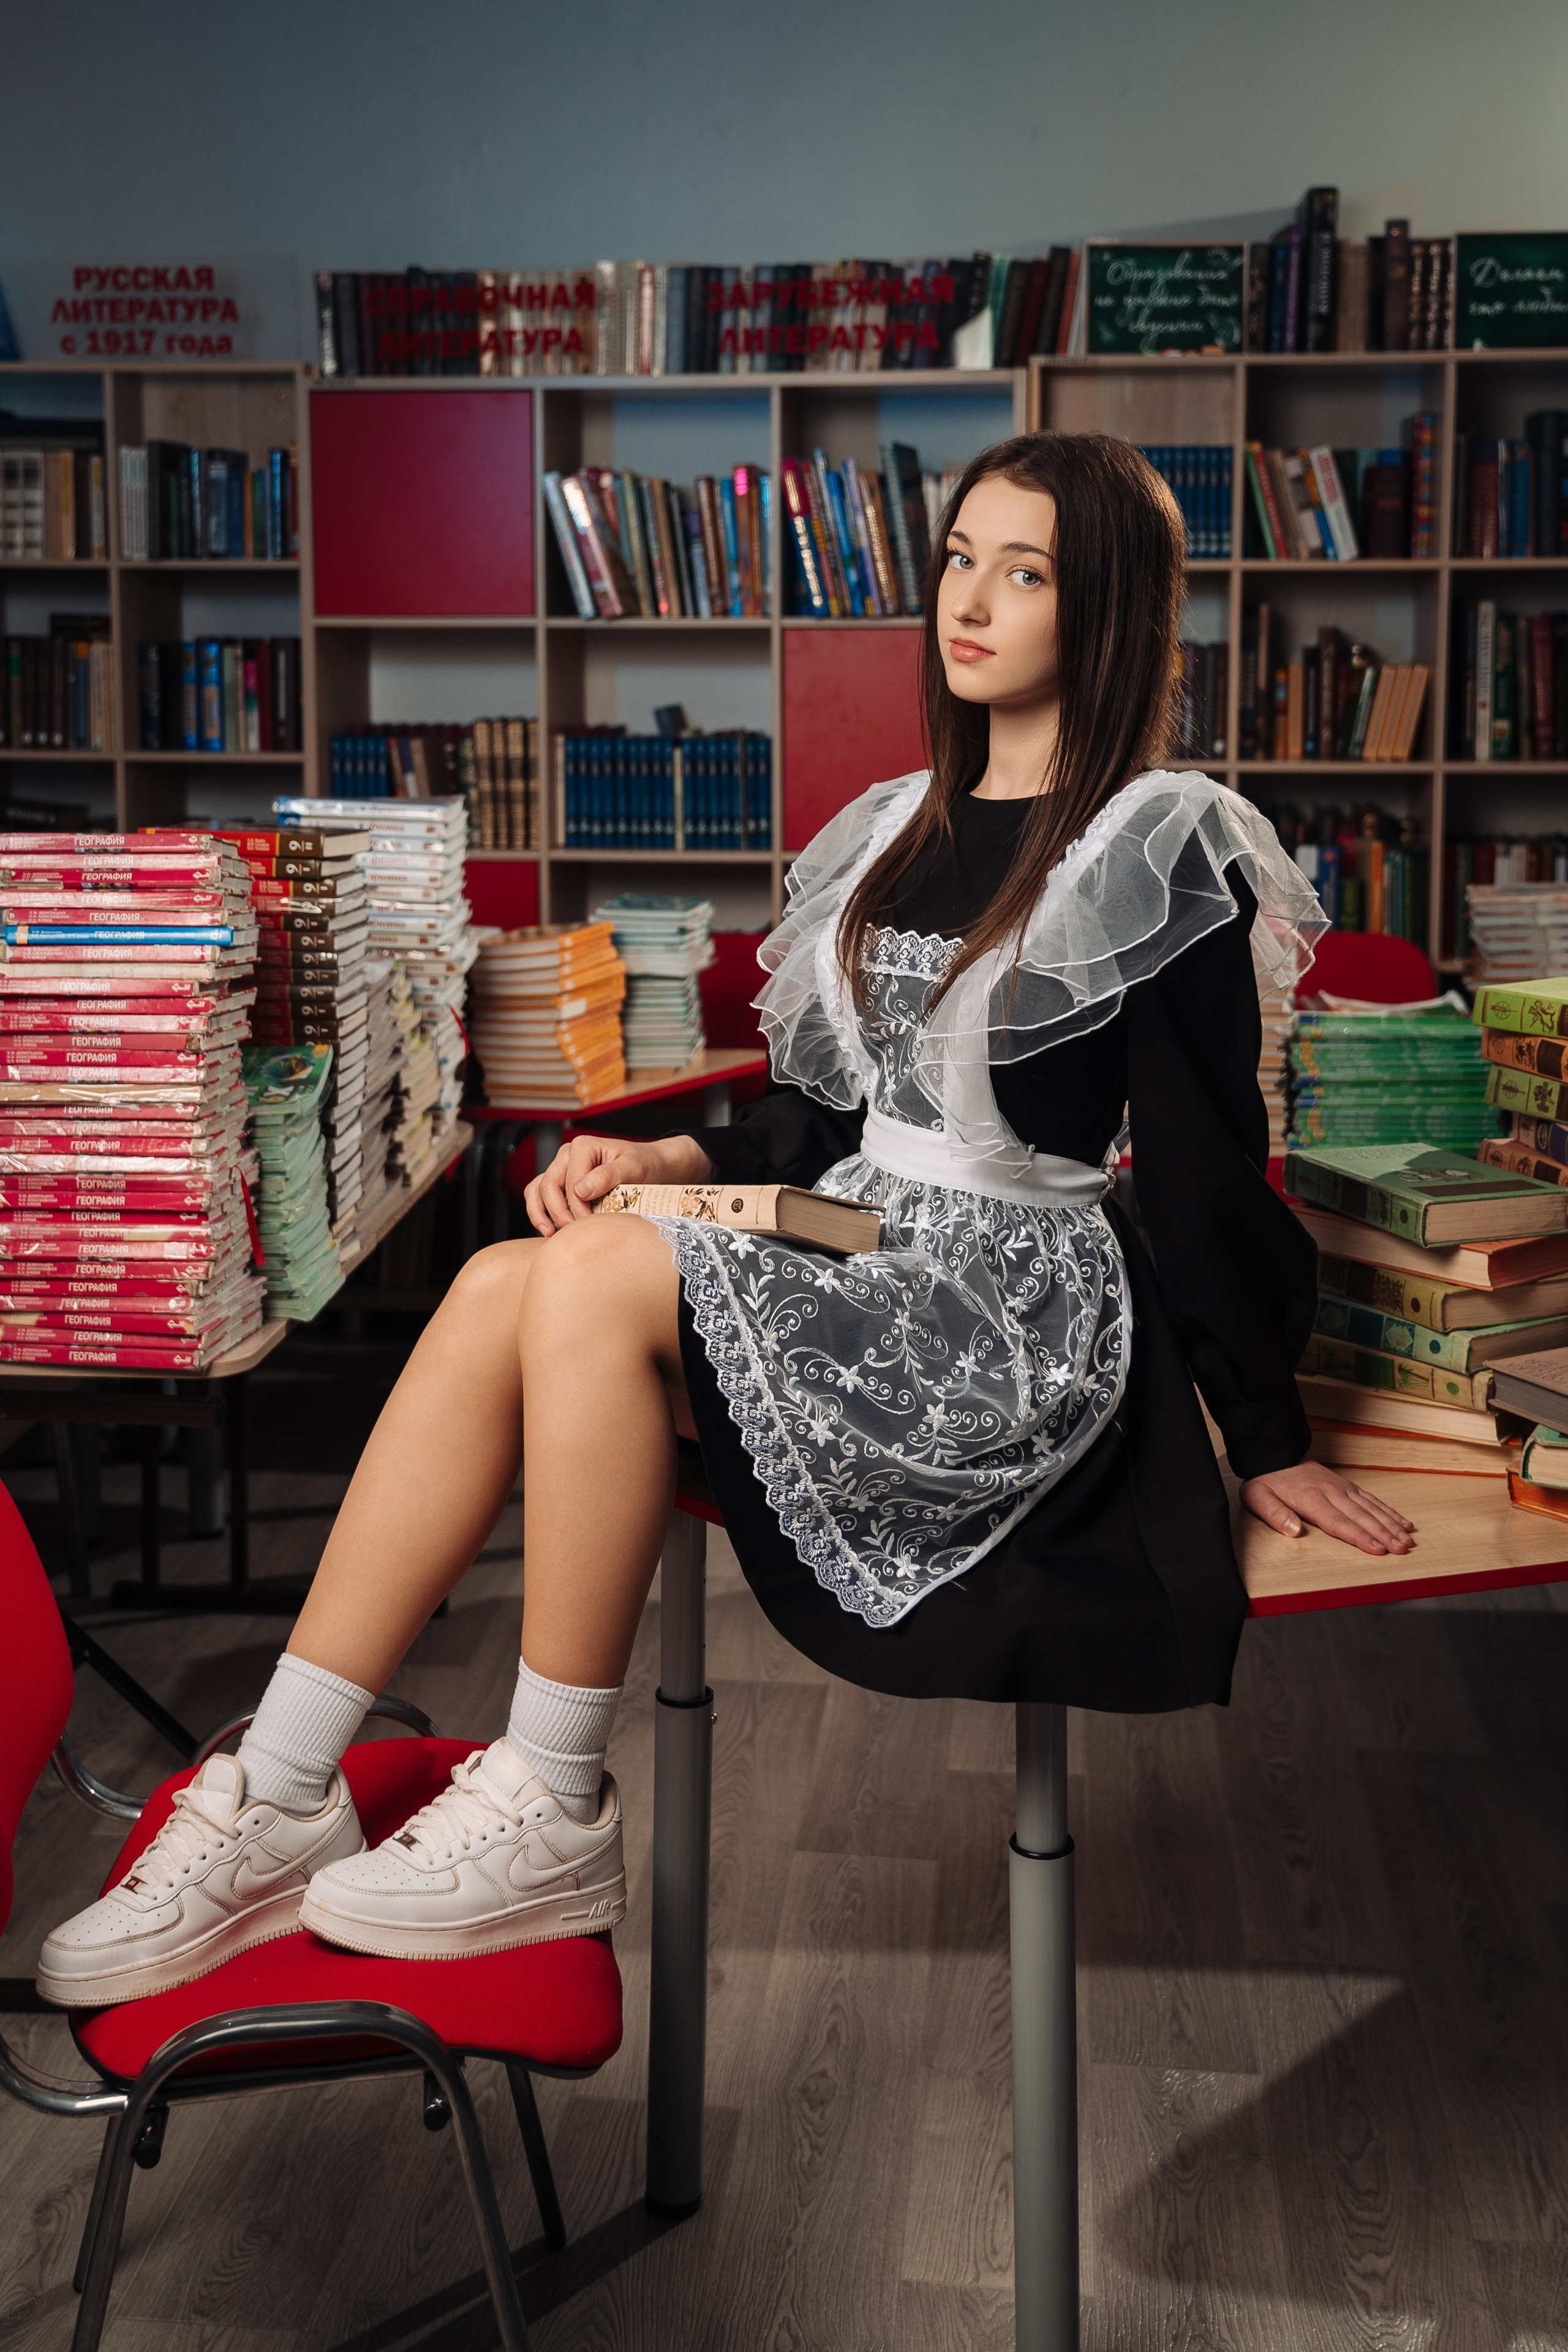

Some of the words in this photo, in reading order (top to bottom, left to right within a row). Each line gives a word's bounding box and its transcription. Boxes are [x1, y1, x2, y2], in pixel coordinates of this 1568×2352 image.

[72, 266, 215, 292] РУССКАЯ
[704, 276, 954, 311] ЗАРУБЕЖНАЯ
[365, 282, 596, 317] СПРАВОЧНАЯ
[51, 298, 239, 323] ЛИТЕРАТУРА
[59, 334, 77, 354] с
[86, 330, 157, 354] 1917
[165, 333, 233, 357] года
[719, 321, 940, 356] ЛИТЕРАТУРА
[377, 328, 584, 360] ЛИТЕРАТУРА
[75, 837, 125, 846] ГЕОГРАФИЯ
[288, 840, 301, 851] 9
[84, 856, 134, 865] ГЕОГРАФИЯ
[285, 864, 299, 874] 9
[303, 883, 316, 893] 9
[89, 913, 140, 921] ГЕОГРАФИЯ
[294, 918, 306, 928] 9
[301, 936, 314, 946] 9
[82, 949, 132, 957] ГЕОГРАФИЯ
[303, 953, 315, 963] 9
[304, 970, 317, 980] 9
[59, 982, 110, 992] ГЕОГРАФИЯ
[300, 987, 312, 997] 9
[77, 1000, 126, 1009] ГЕОГРАФИЯ
[301, 1006, 314, 1015] 9
[69, 1017, 119, 1026] ГЕОГРАФИЯ
[304, 1025, 317, 1035] 9
[72, 1037, 121, 1046] ГЕОГРАФИЯ
[67, 1053, 116, 1062] ГЕОГРАФИЯ
[68, 1068, 118, 1077] ГЕОГРАФИЯ
[72, 1123, 121, 1132] ГЕОГРАФИЯ
[70, 1141, 121, 1150] ГЕОГРАФИЯ
[76, 1178, 126, 1189] ГЕОГРАФИЯ
[76, 1196, 125, 1205] ГЕОГРАФИЯ
[645, 1188, 654, 1215] РДОУСИ
[651, 1190, 660, 1215] ИЗАМИ
[659, 1188, 668, 1214] УСТАВЕЛИ
[71, 1212, 121, 1221] ГЕОГРАФИЯ
[78, 1245, 129, 1254] ГЕОГРАФИЯ
[76, 1265, 126, 1274] ГЕОГРАФИЯ
[68, 1282, 118, 1292] ГЕОГРАФИЯ
[64, 1315, 111, 1325] ГЕОГРАФИЯ
[74, 1332, 122, 1341] ГЕОГРАФИЯ
[69, 1351, 116, 1362] ГЕОГРАФИЯ
[589, 1899, 610, 1919] AIR
